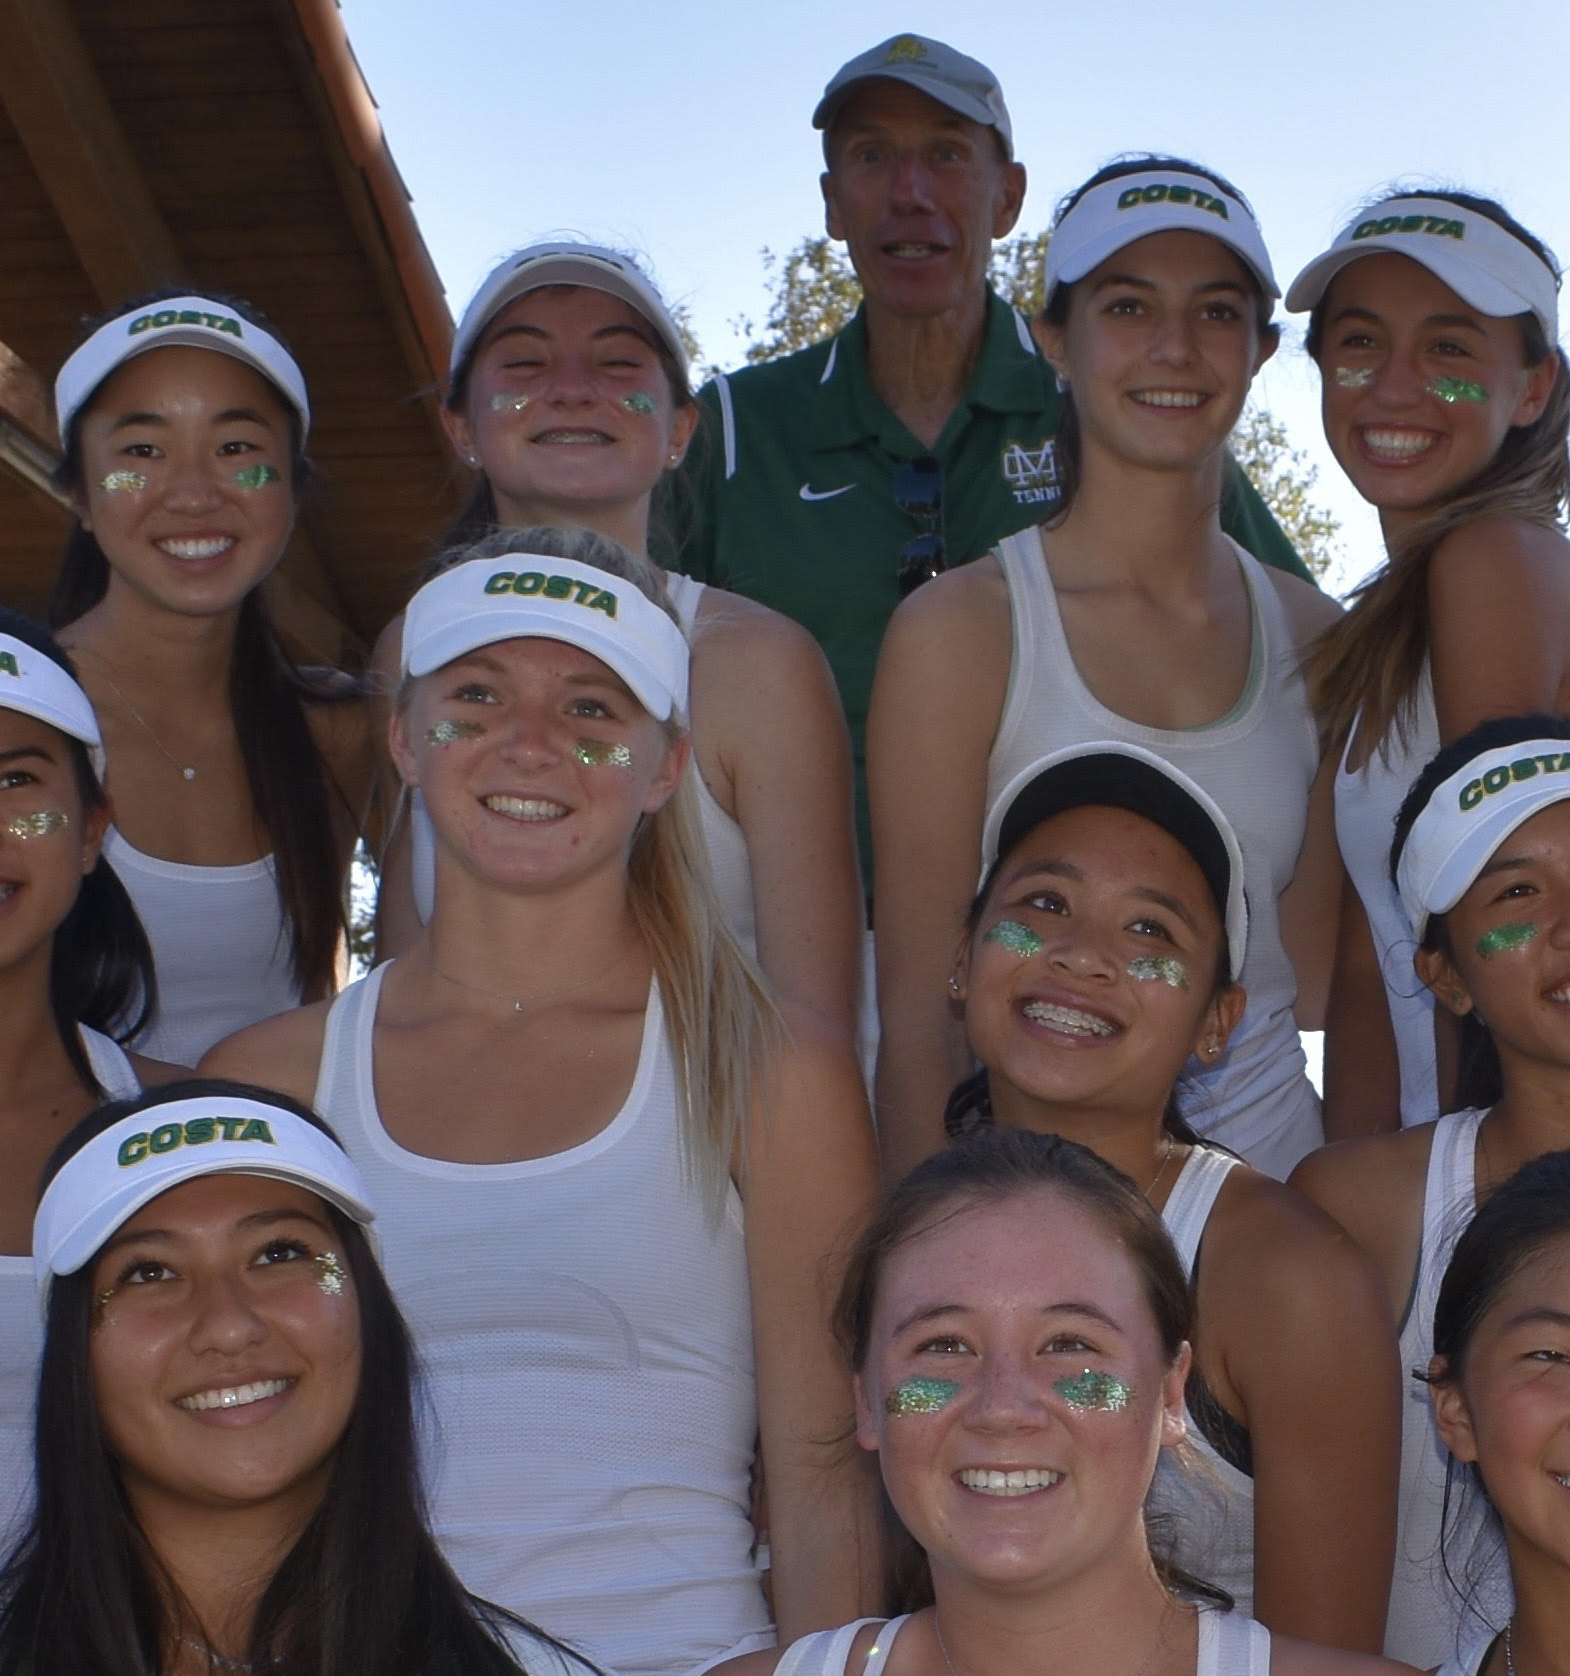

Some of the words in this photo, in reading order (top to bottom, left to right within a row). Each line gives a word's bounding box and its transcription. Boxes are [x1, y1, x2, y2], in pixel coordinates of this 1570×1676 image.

[1118, 184, 1229, 221] COSTA
[1351, 215, 1466, 240] COSTA
[128, 309, 243, 339] COSTA
[1013, 486, 1061, 503] TENNI
[484, 571, 618, 621] COSTA
[117, 1116, 278, 1169] COSTA
